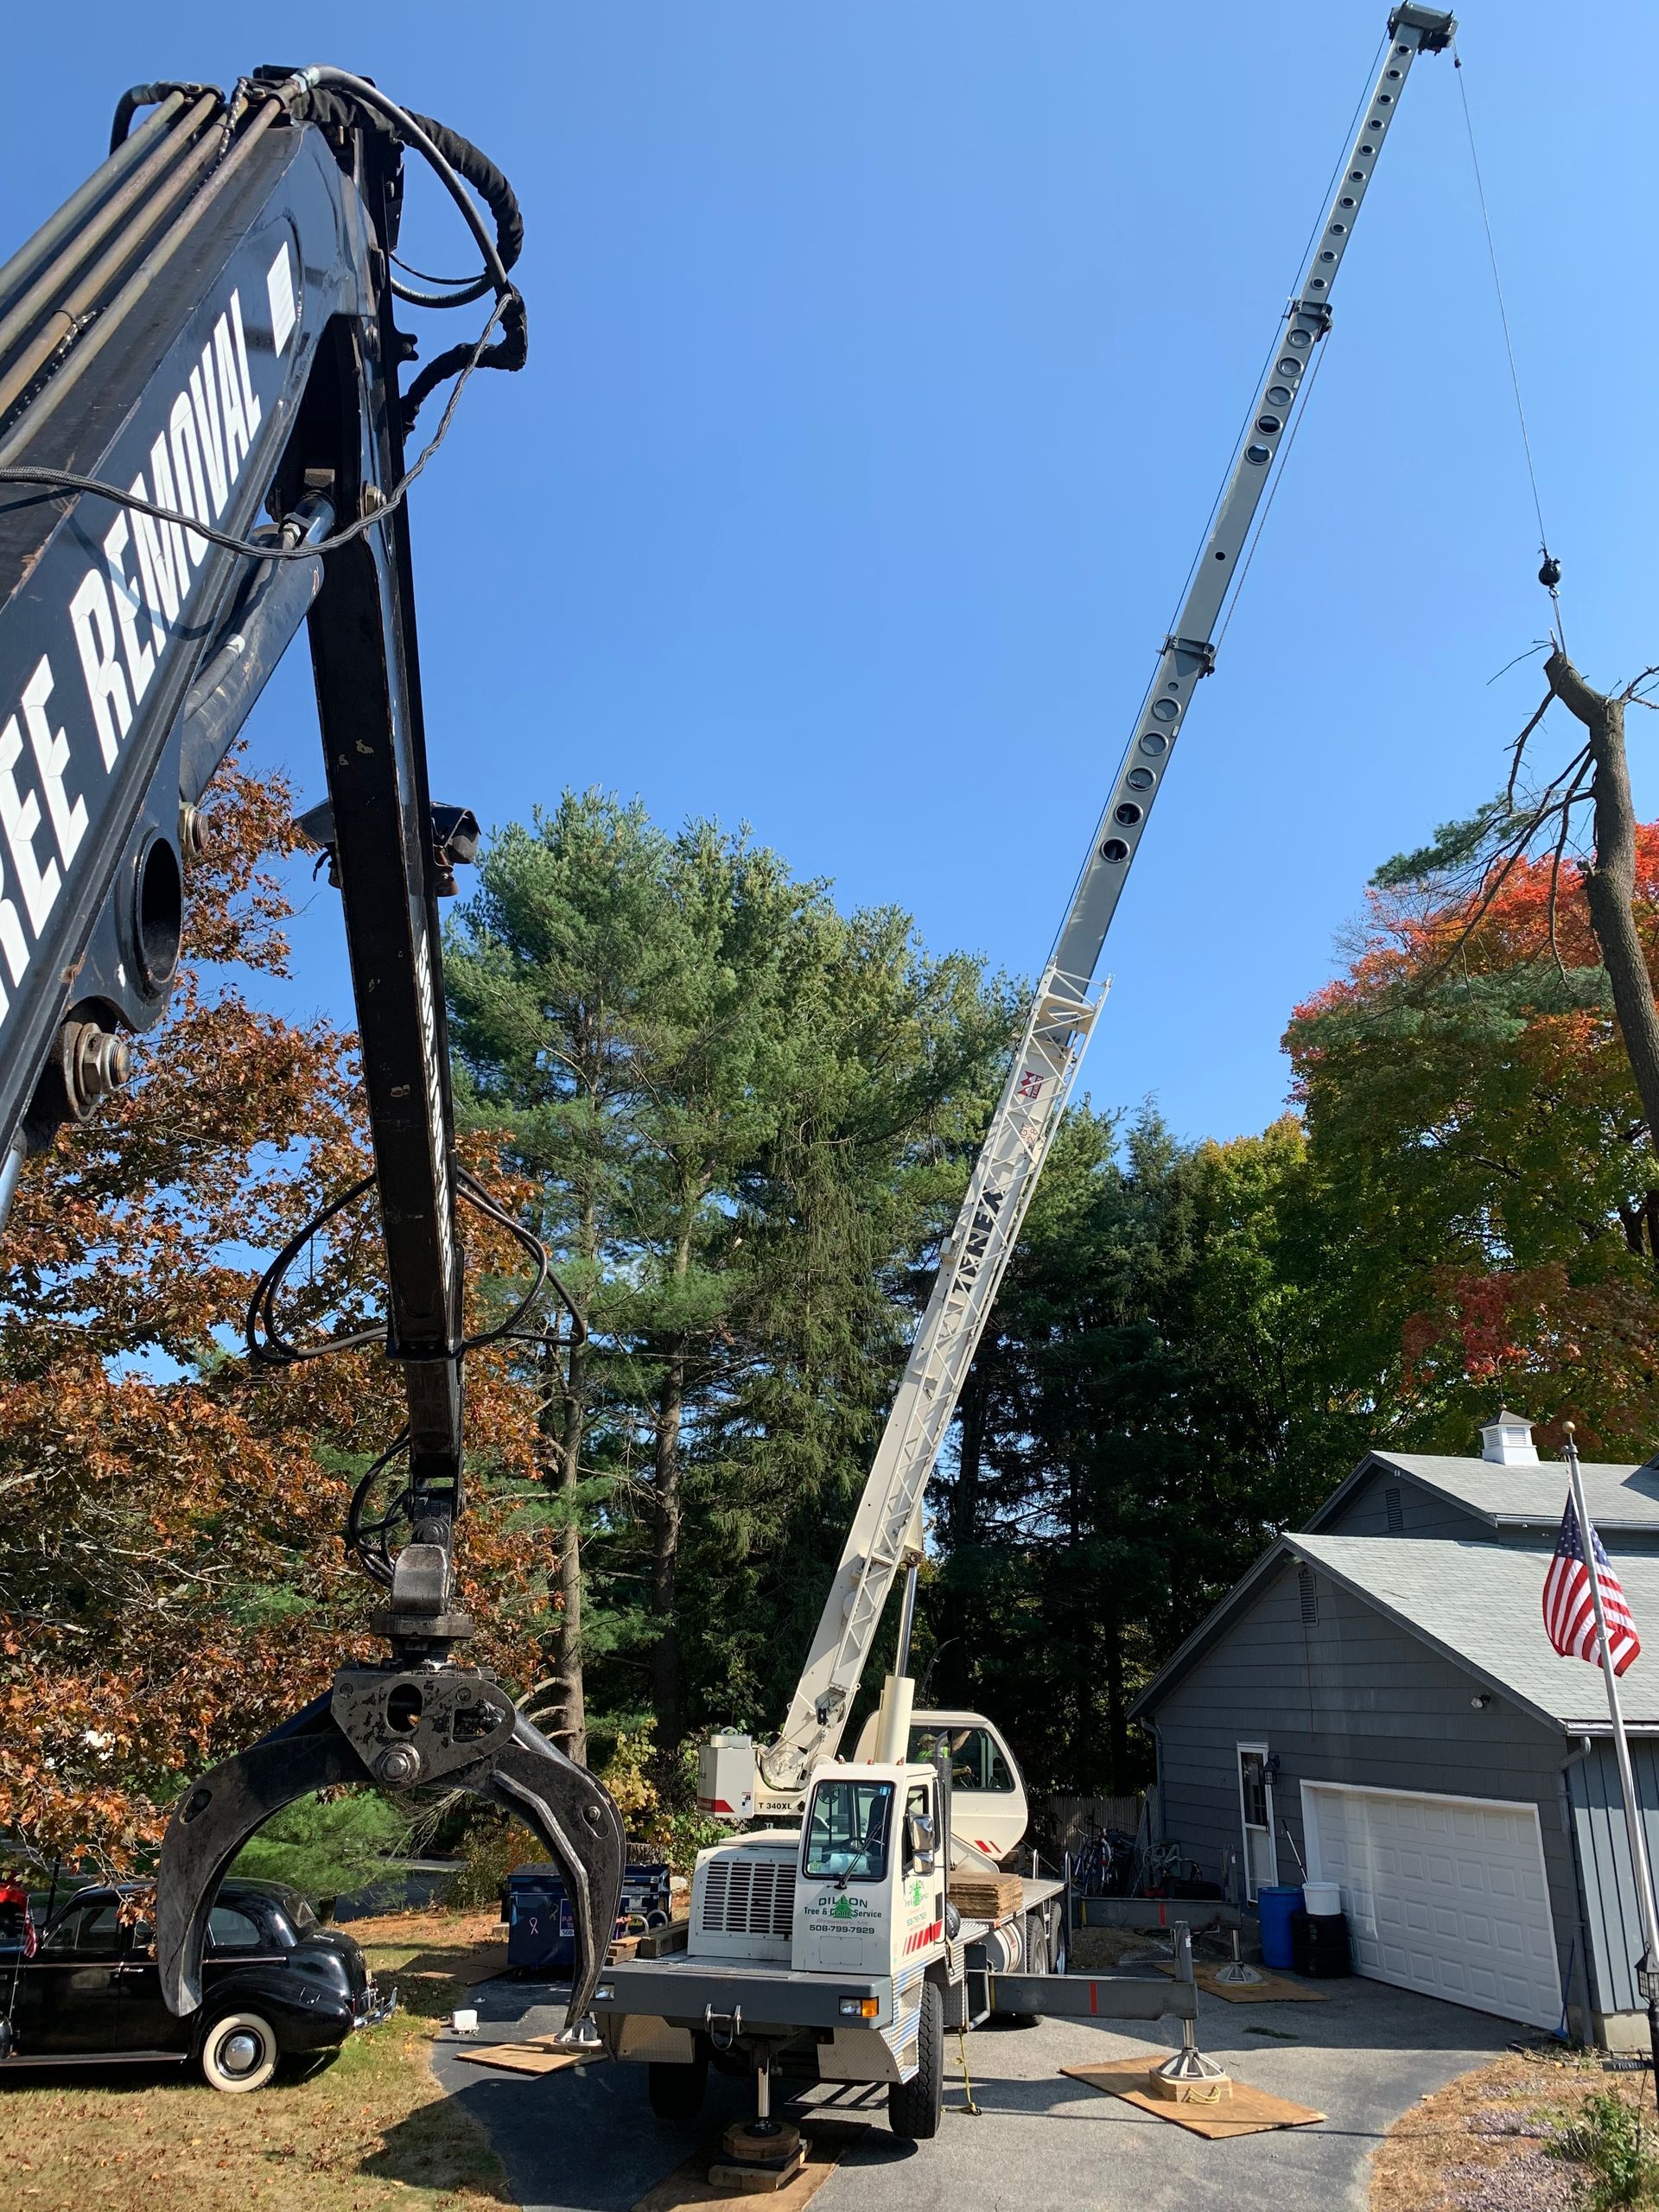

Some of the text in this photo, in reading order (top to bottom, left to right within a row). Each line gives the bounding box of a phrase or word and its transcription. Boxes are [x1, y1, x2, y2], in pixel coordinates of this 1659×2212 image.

[69, 287, 262, 774] REMOVAL
[818, 1897, 868, 1909] DILLON
[804, 1906, 820, 1915] Tree
[830, 1908, 852, 1916] Crane
[854, 1909, 882, 1918] Service
[810, 1924, 875, 1935] 508-799-7929
